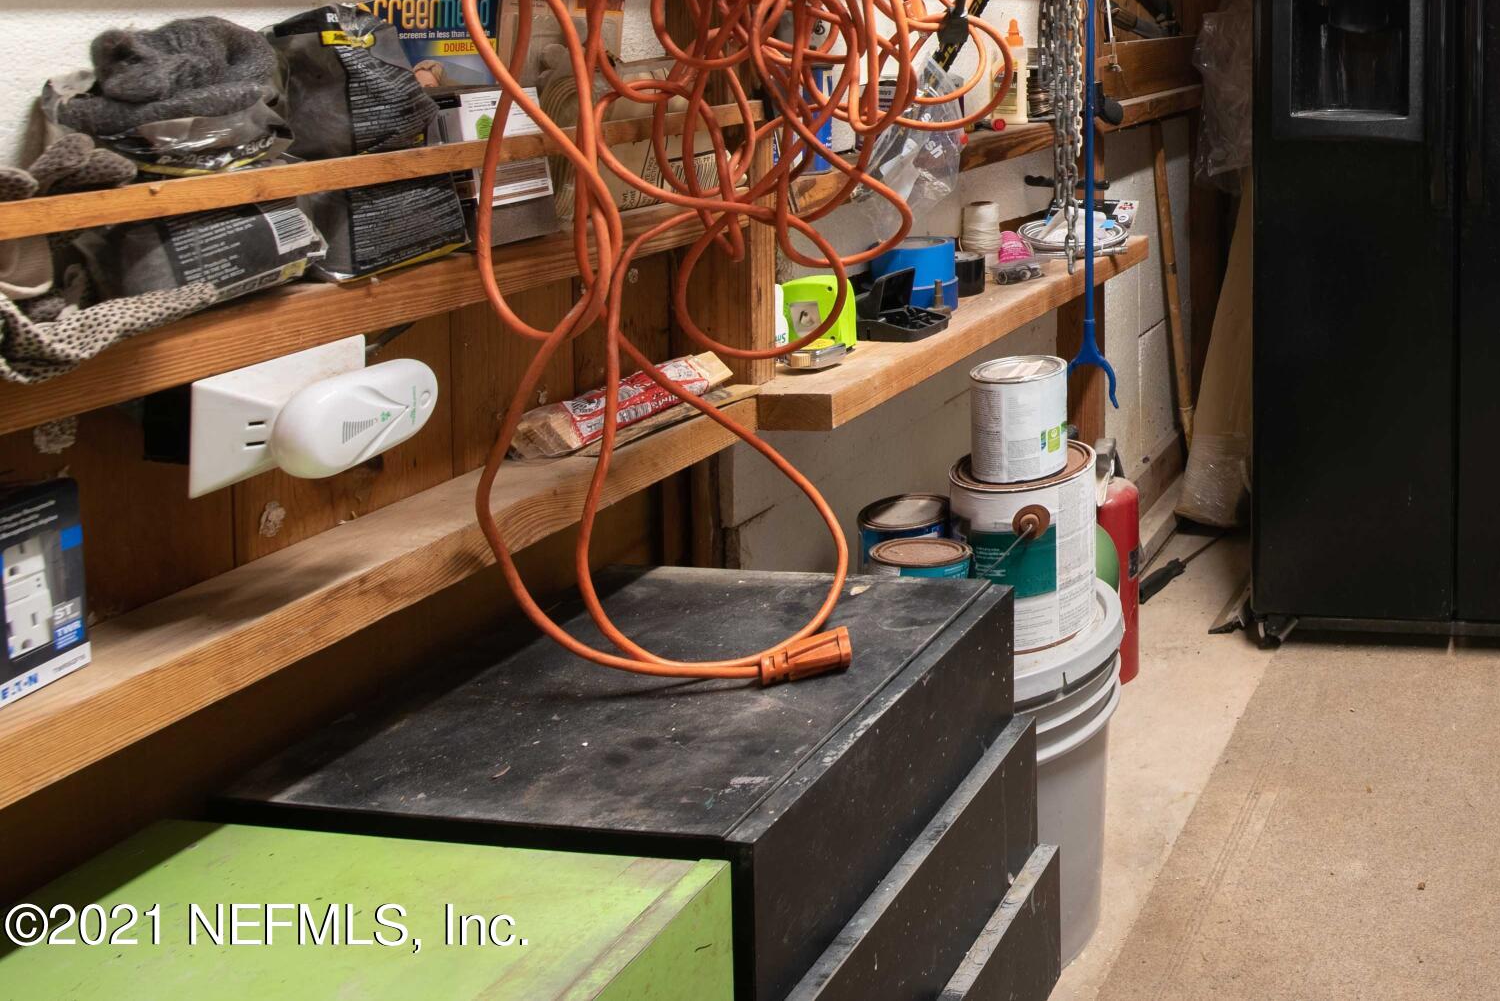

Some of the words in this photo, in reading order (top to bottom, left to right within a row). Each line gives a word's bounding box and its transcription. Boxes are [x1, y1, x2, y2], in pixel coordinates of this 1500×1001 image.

[398, 31, 427, 40] screens
[428, 30, 436, 39] in
[436, 30, 450, 39] less
[451, 30, 465, 38] than
[443, 42, 474, 53] DOUBLE
[54, 602, 75, 621] ST
